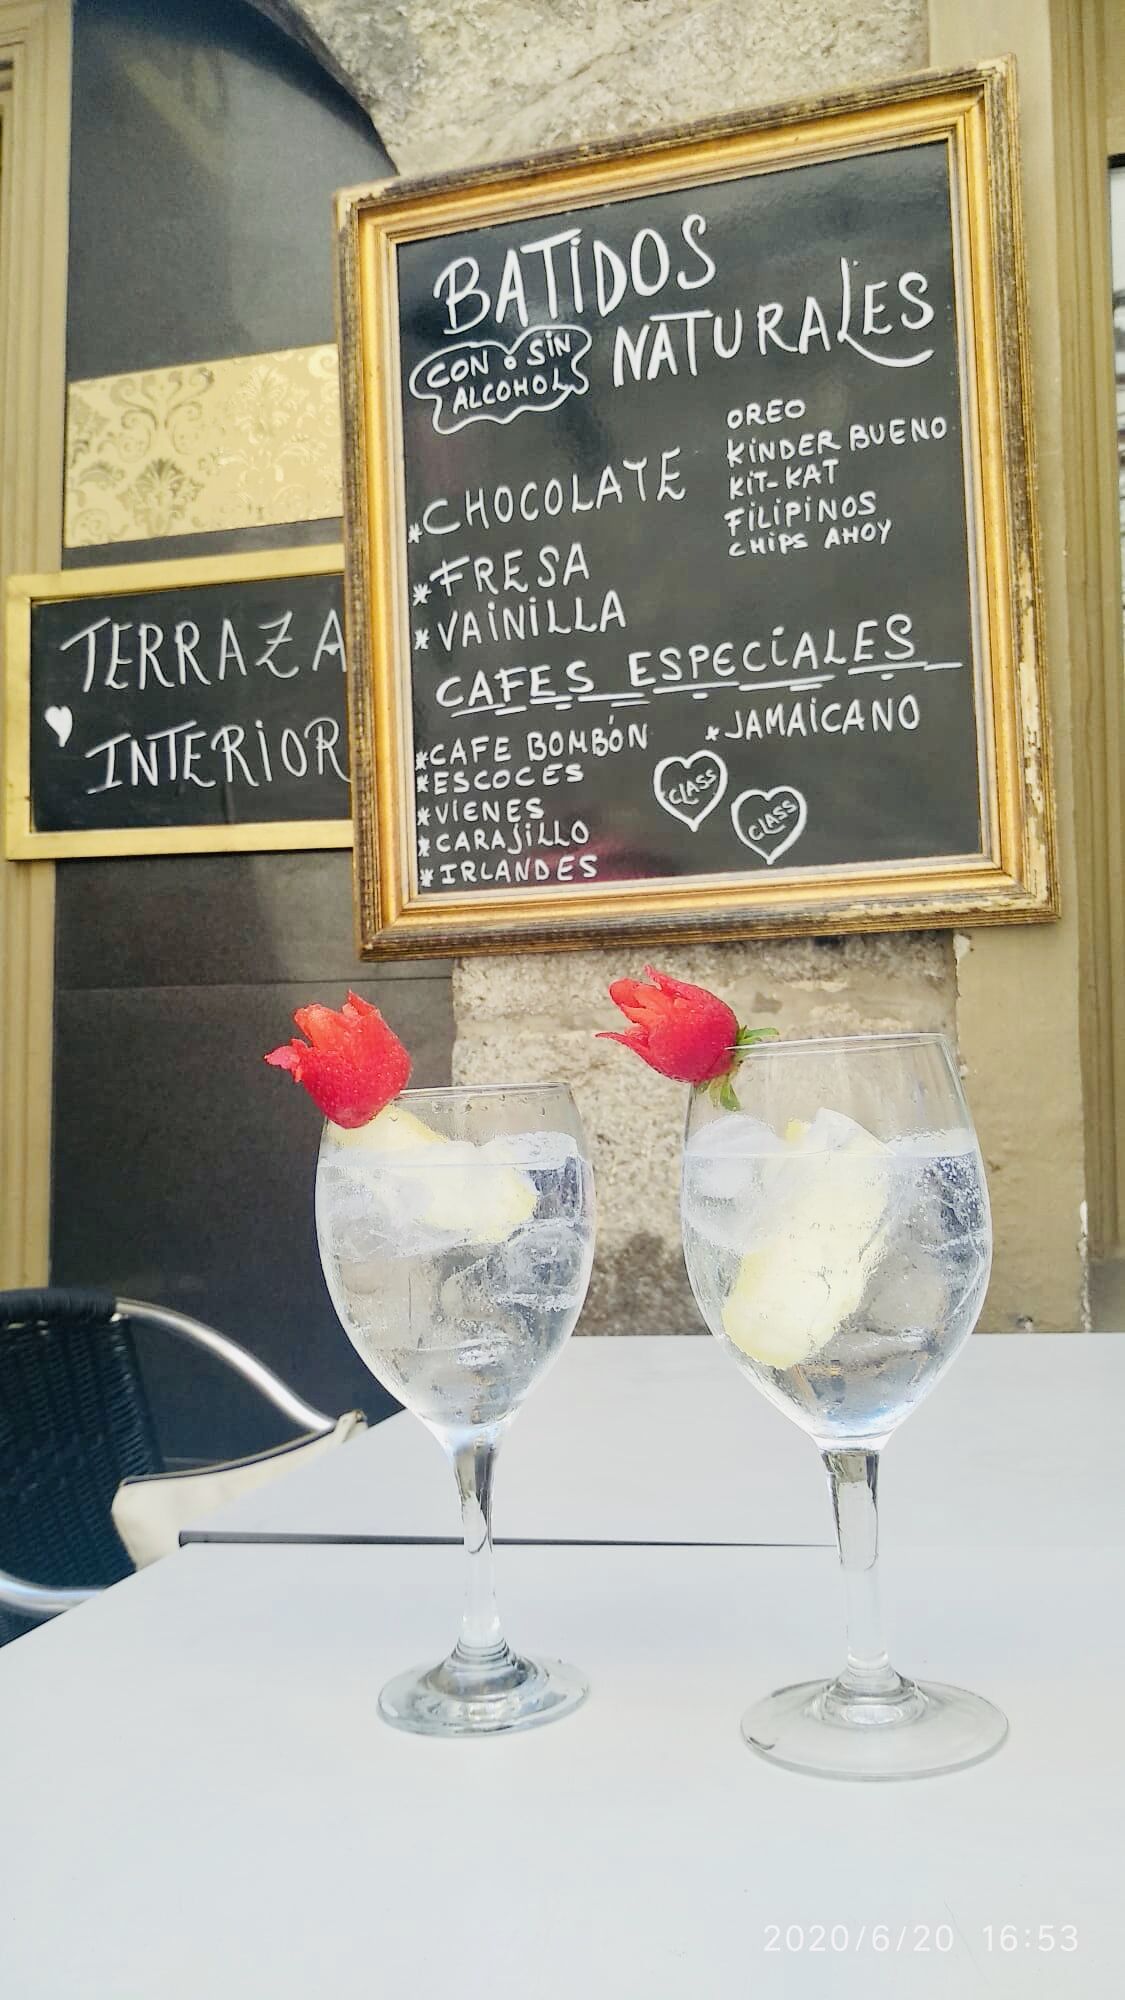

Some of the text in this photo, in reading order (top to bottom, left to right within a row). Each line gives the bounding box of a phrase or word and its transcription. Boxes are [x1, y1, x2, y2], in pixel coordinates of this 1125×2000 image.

[612, 256, 936, 388] NATURALES
[426, 350, 489, 389] CON
[452, 367, 570, 415] ALCOHOL
[726, 399, 806, 430] OREO
[850, 416, 948, 452] BUENO
[421, 446, 687, 536] CHOCOLATE
[824, 518, 893, 550] AHOY
[429, 542, 590, 597] FRESA
[60, 608, 346, 693] TERRAZA
[435, 660, 595, 708] CAFES
[430, 736, 511, 766] CAFE
[433, 763, 584, 796] ESCOCES
[668, 768, 717, 805] CLASS
[748, 800, 797, 841] CLASS
[440, 854, 598, 886] IRLANDES
